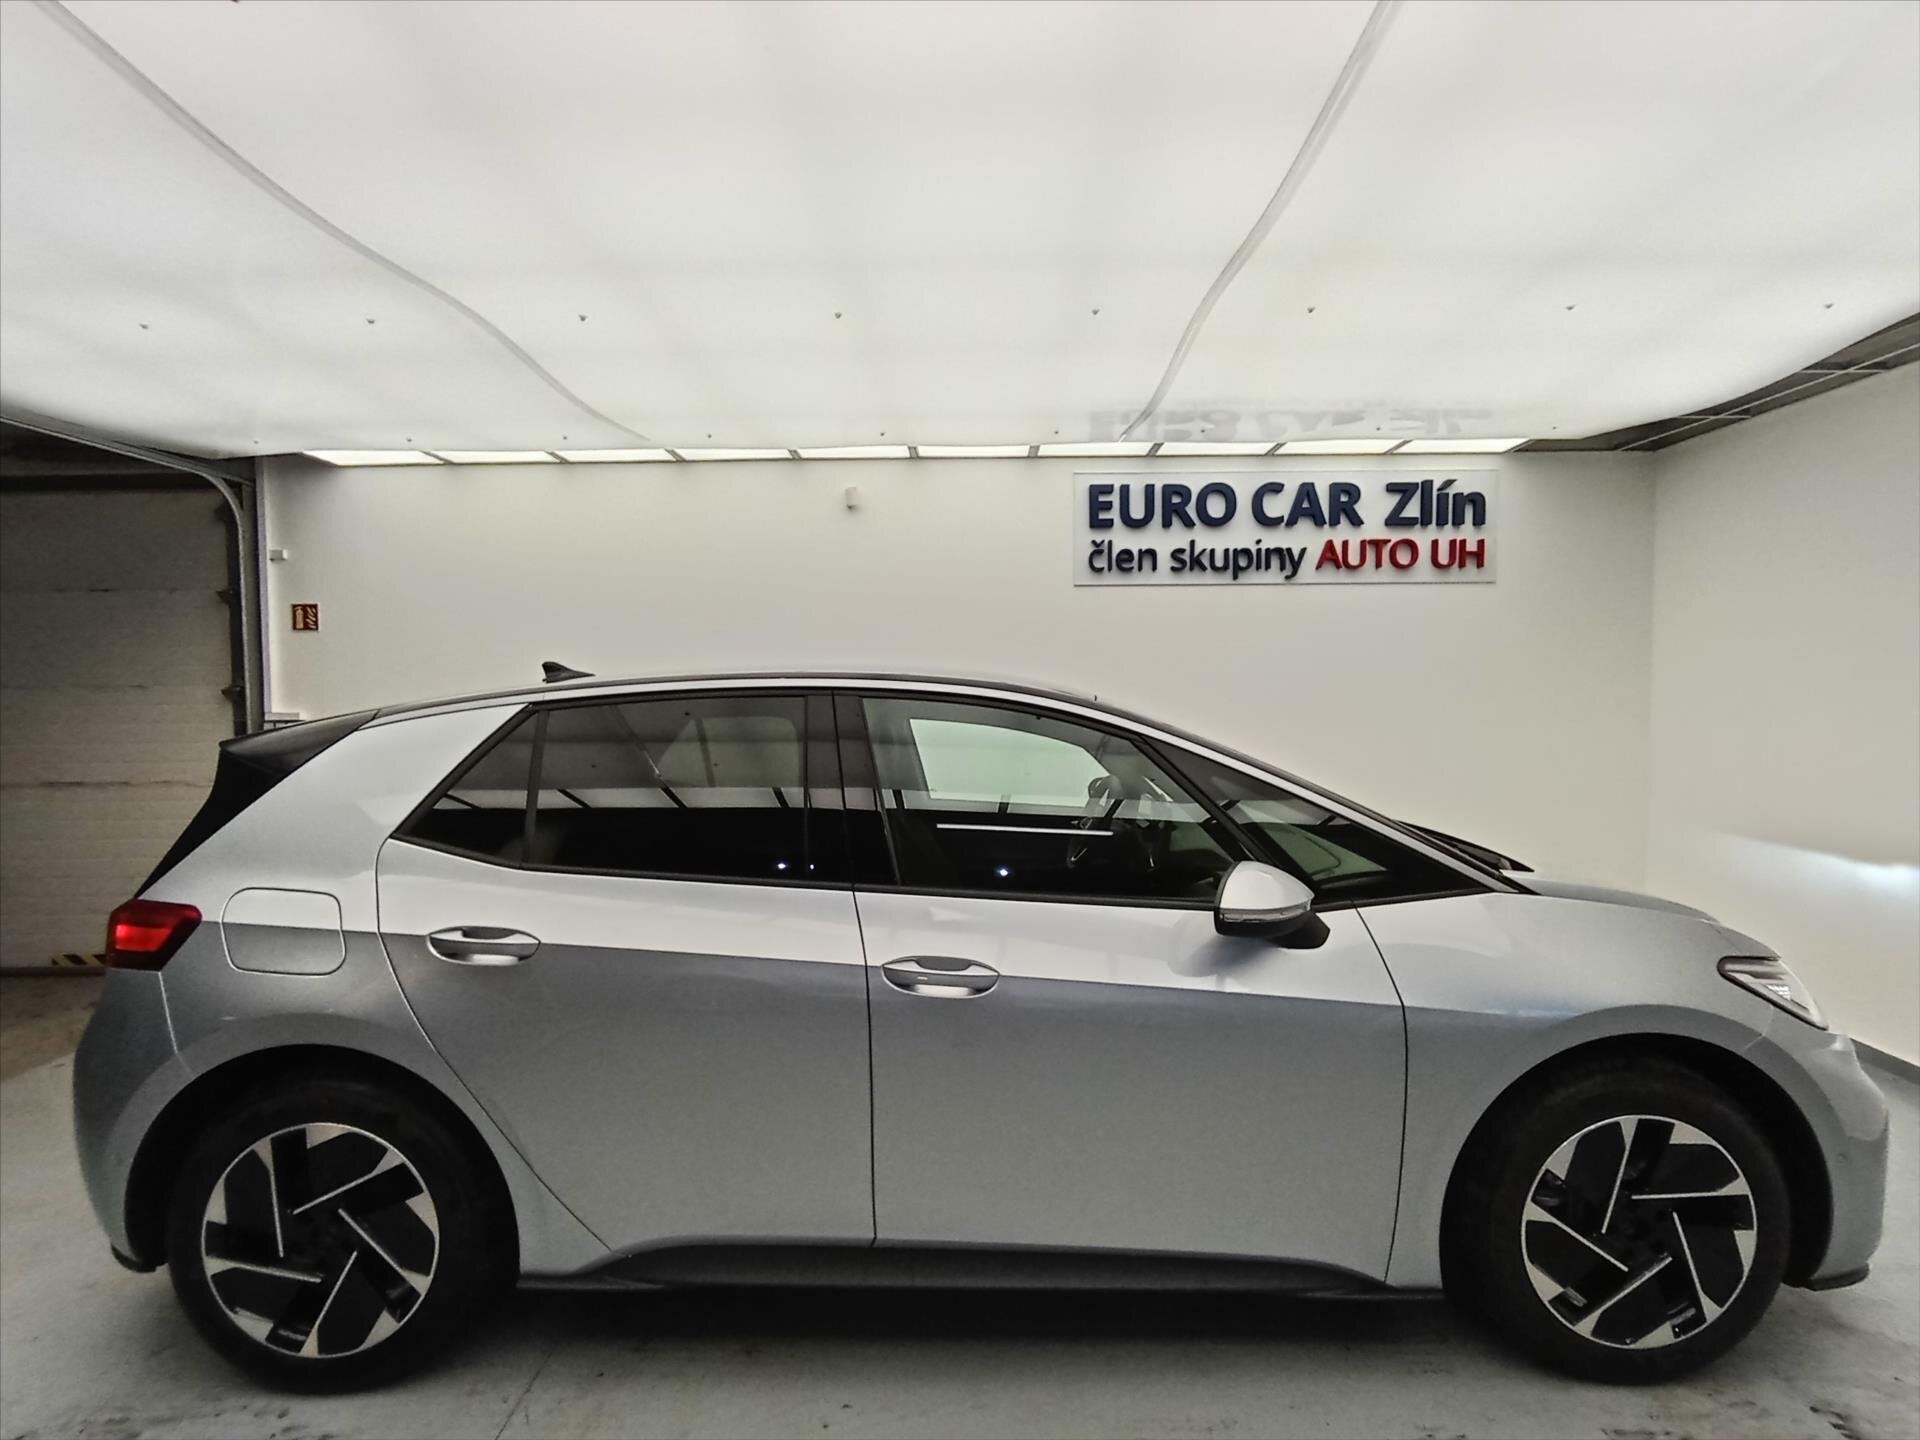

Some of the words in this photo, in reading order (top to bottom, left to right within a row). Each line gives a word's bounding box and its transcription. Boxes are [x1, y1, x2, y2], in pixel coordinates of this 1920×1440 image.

[1088, 482, 1237, 529] EURO
[1251, 482, 1364, 528] CAR
[1384, 478, 1487, 528] Zlín
[1088, 539, 1158, 573] člen
[1315, 538, 1420, 571] AUTO
[1429, 538, 1486, 570] UH
